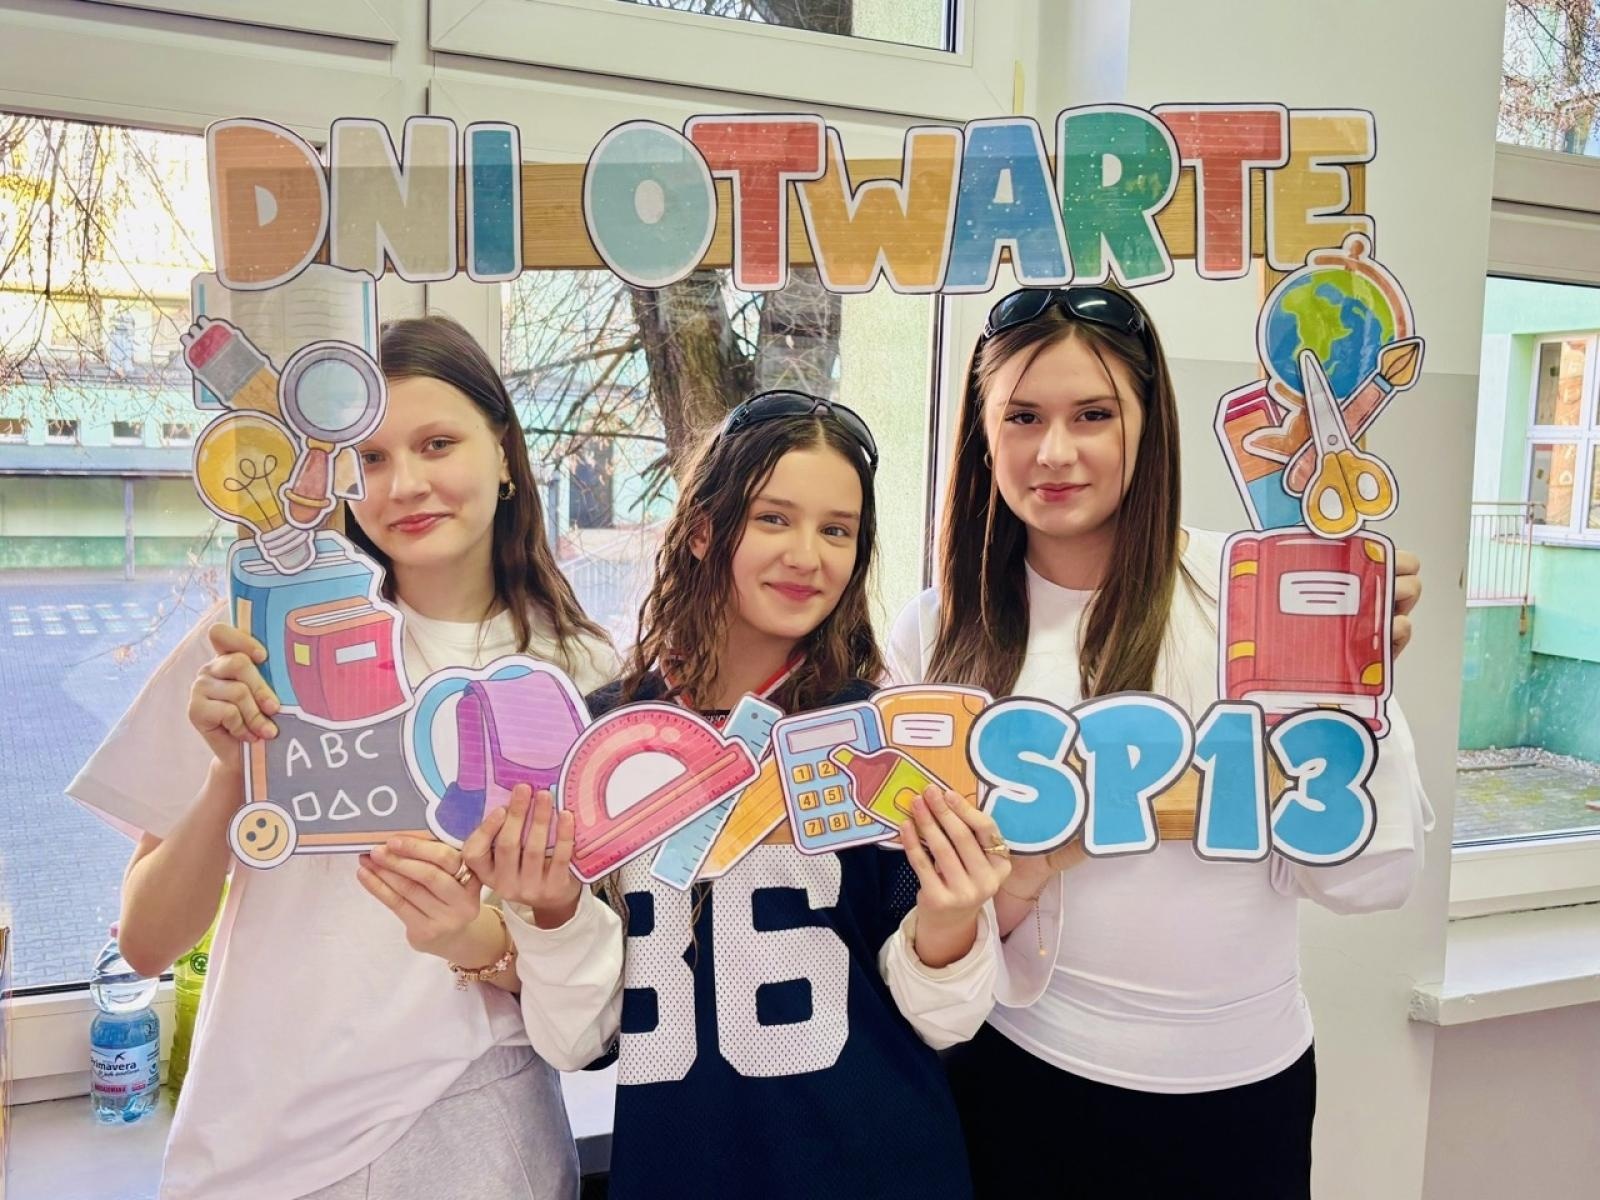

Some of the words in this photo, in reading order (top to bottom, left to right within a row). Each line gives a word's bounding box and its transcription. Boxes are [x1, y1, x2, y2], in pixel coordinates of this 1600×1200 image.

[206, 116, 523, 291] DNI
[583, 103, 1377, 293] OTWARTE
[966, 691, 1379, 866] SP13
